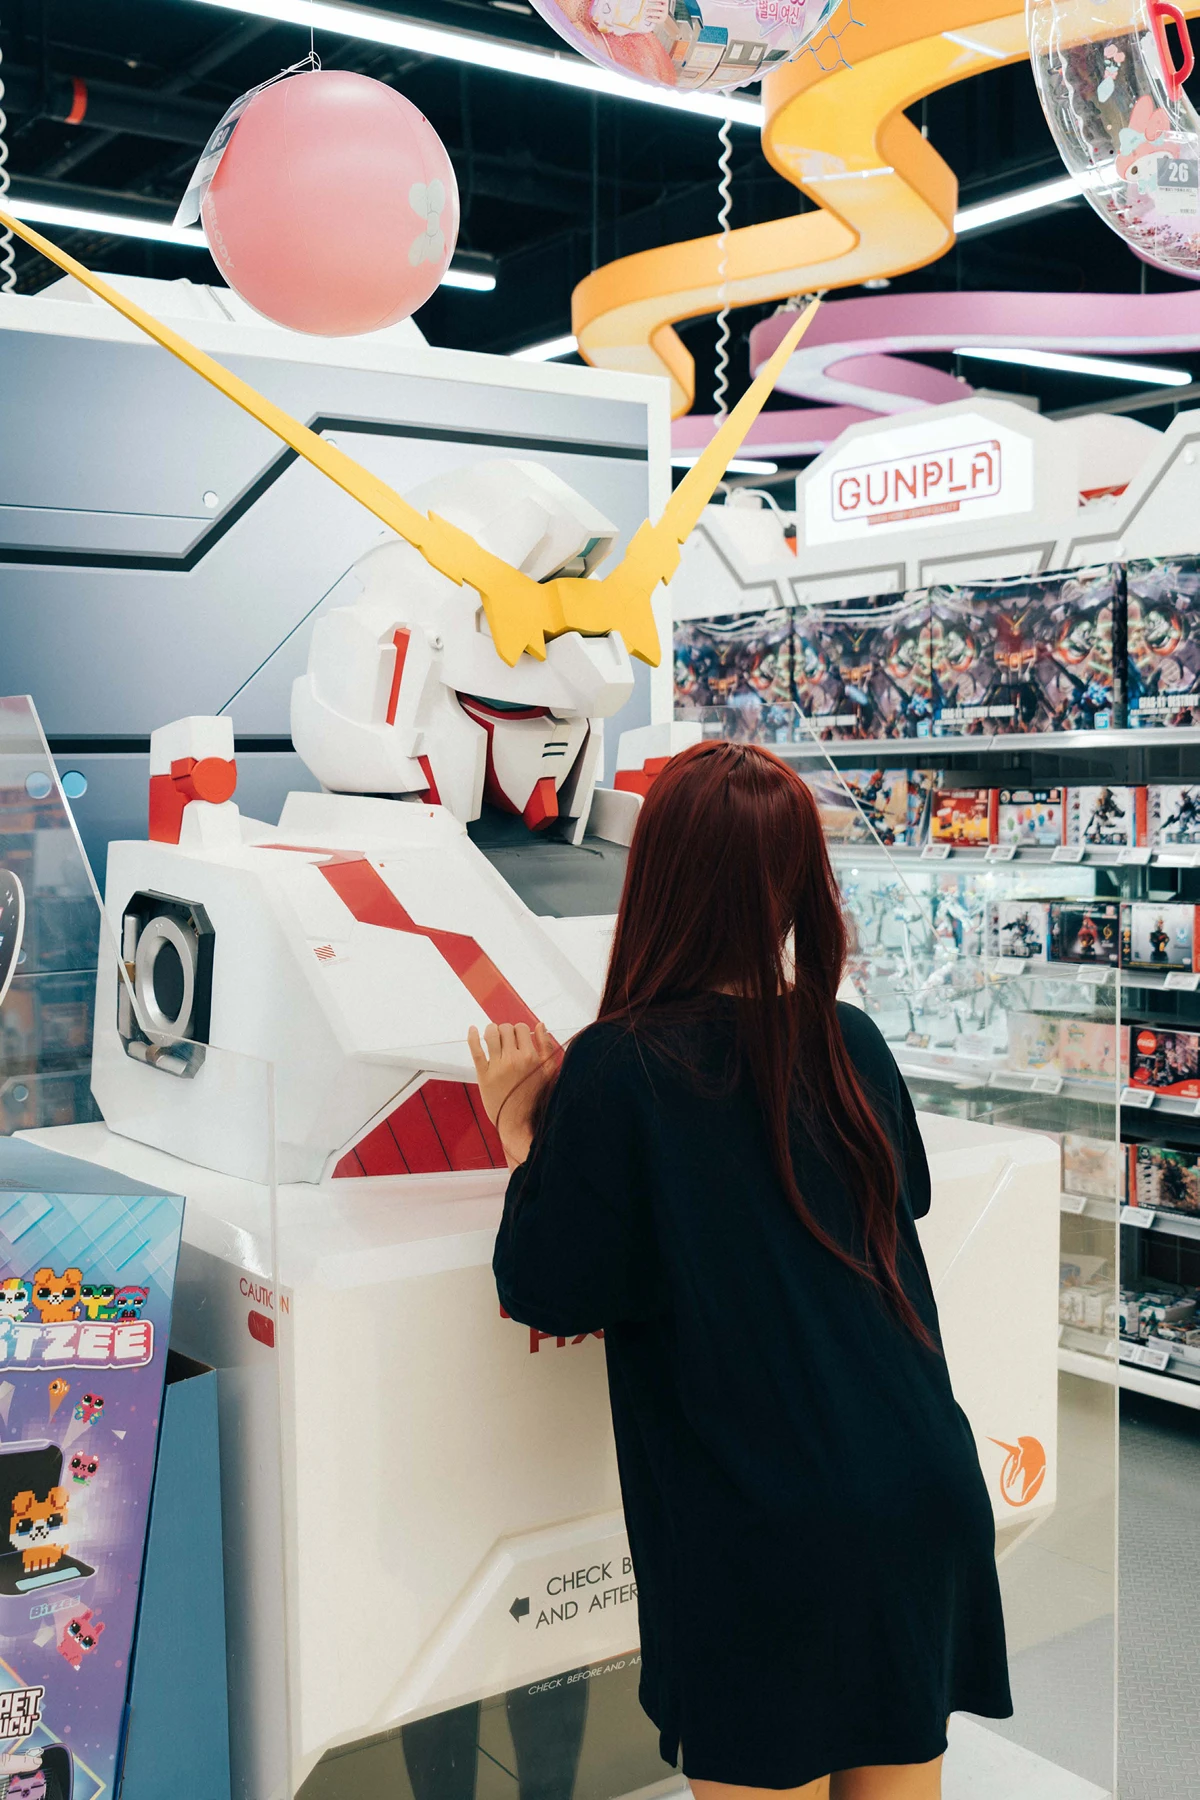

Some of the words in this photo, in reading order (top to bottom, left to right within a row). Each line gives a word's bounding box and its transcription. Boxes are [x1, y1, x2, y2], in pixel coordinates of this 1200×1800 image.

[781, 5, 800, 24] 여신
[1168, 162, 1189, 182] 26
[839, 452, 993, 511] GUNPLA
[546, 1561, 612, 1596] CHECK
[535, 1601, 578, 1629] AND
[588, 1582, 639, 1613] AFTER
[528, 1678, 563, 1695] CHECK
[566, 1667, 603, 1685] BEFORE
[603, 1660, 625, 1674] AND
[0, 1690, 41, 1717] PET
[0, 1716, 31, 1737] UCH
